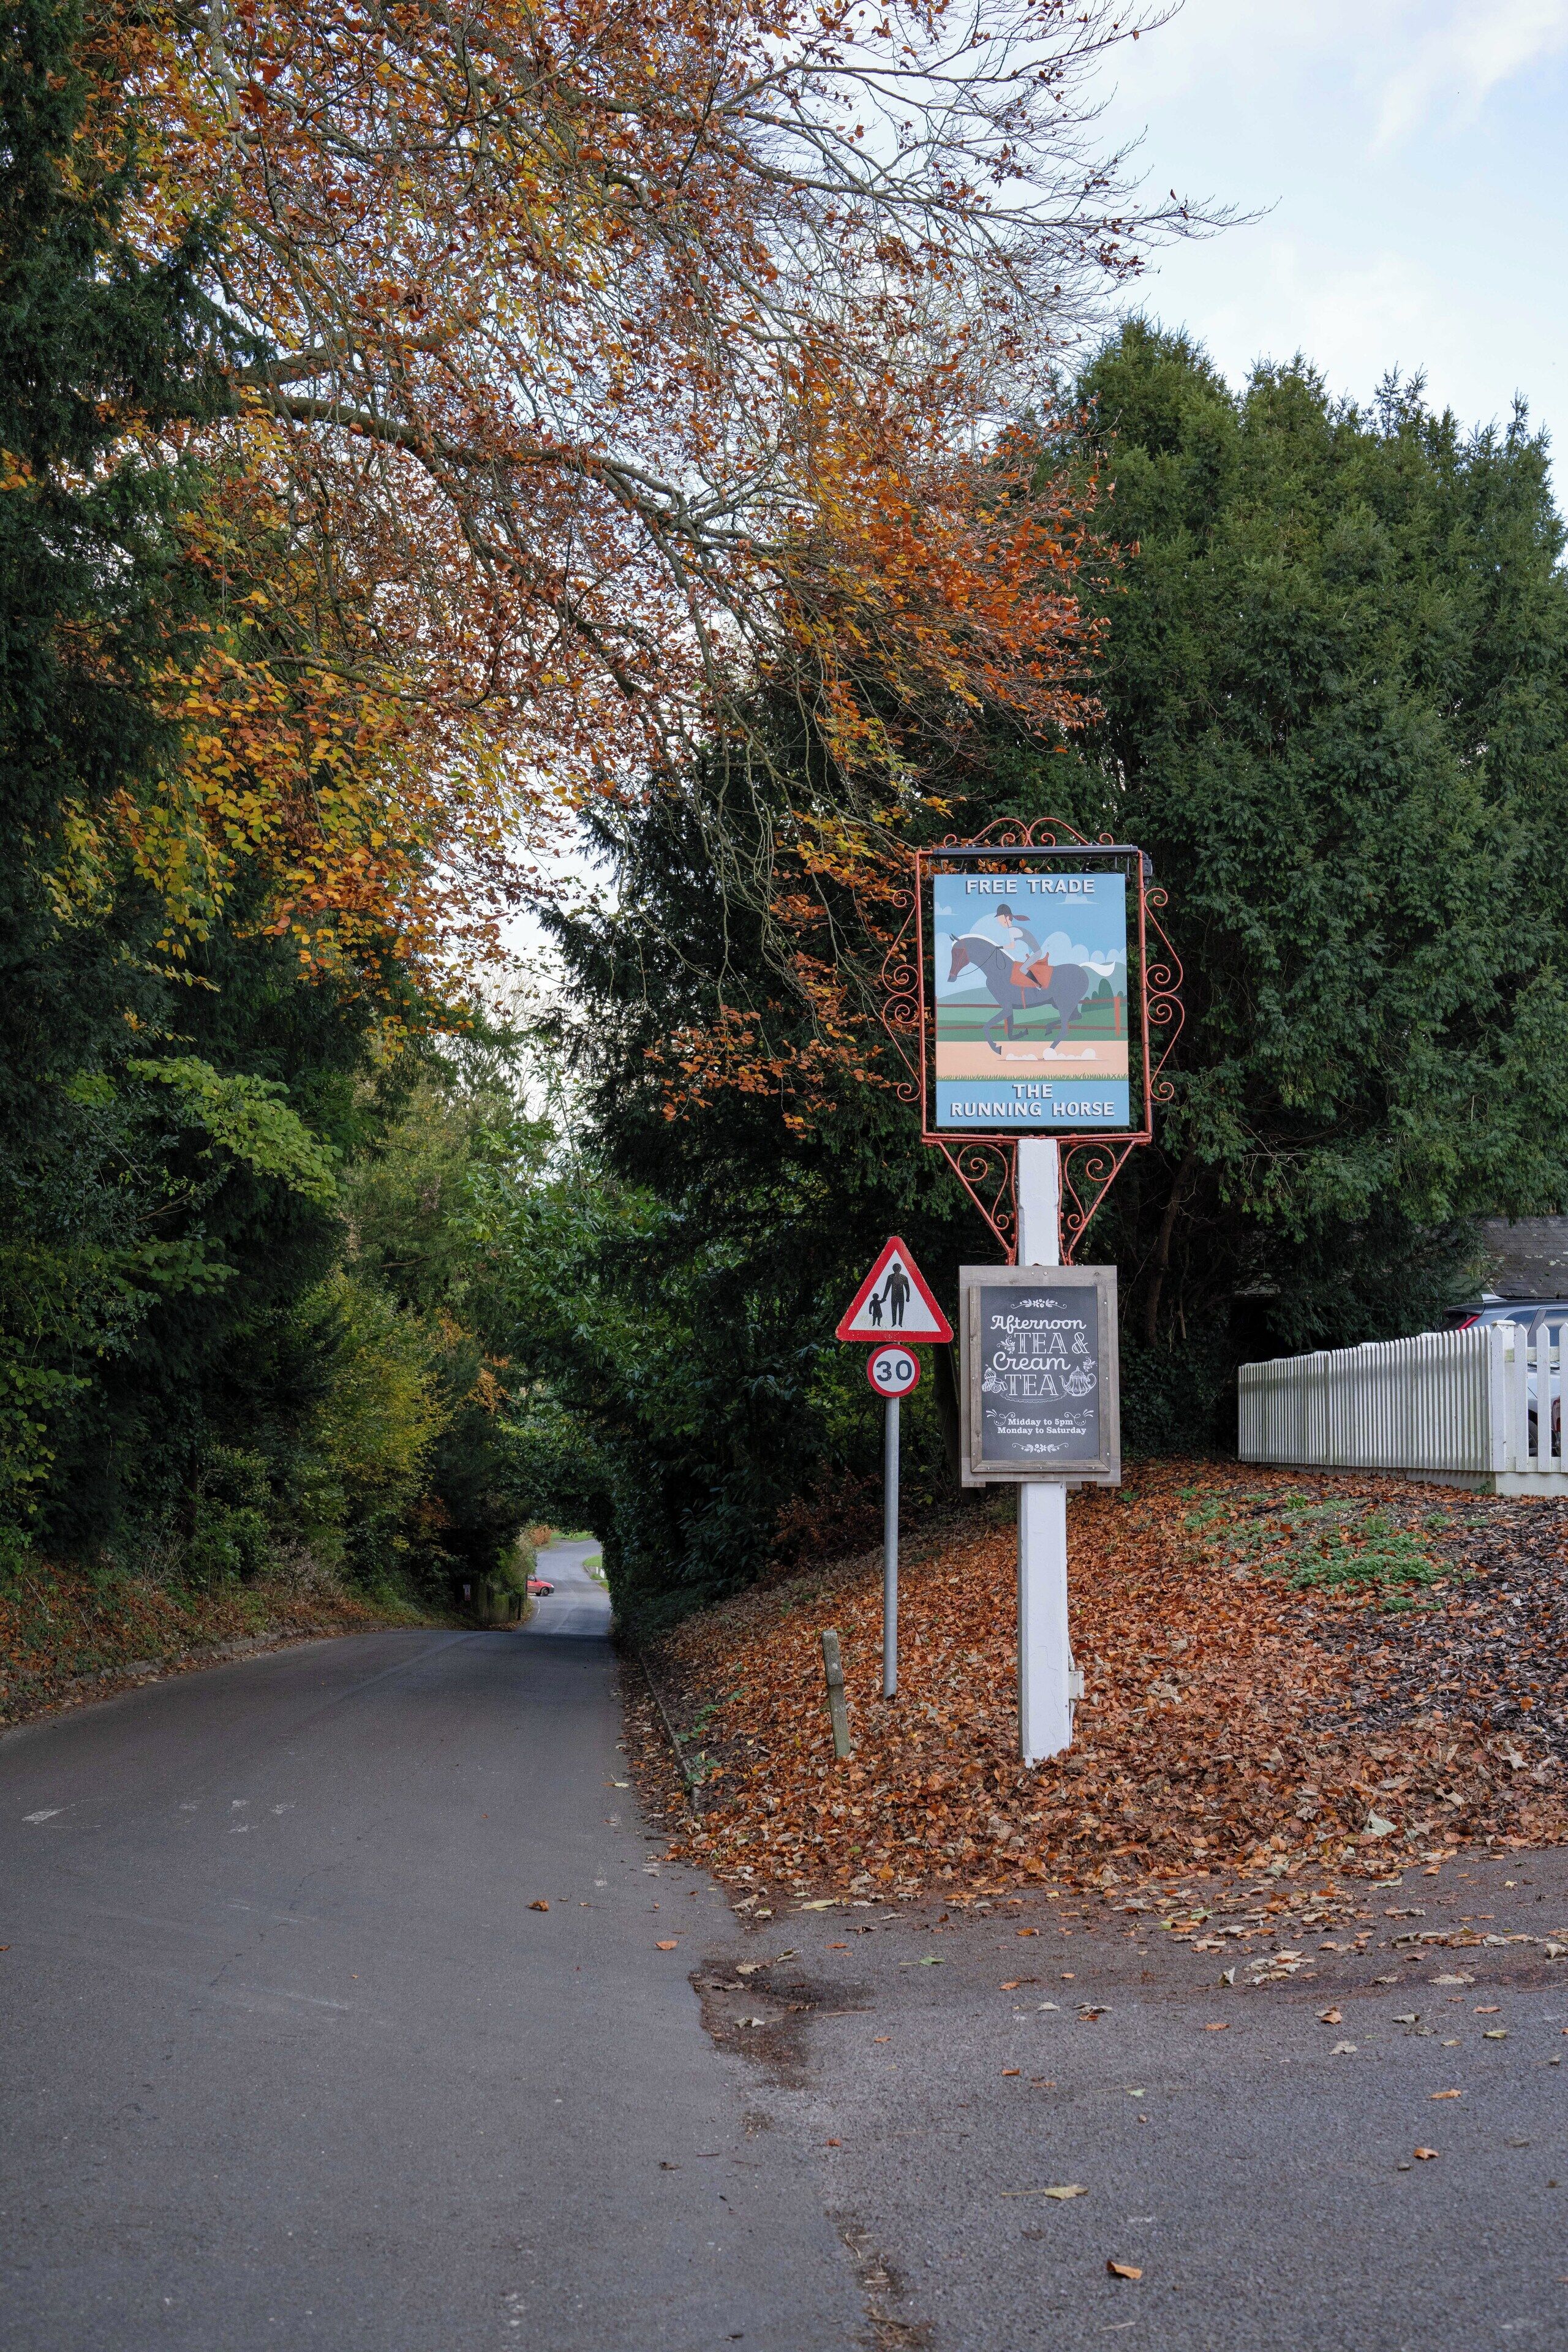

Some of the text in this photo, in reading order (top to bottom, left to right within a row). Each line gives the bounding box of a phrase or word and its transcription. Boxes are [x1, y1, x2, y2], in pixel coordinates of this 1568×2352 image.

[965, 879, 1096, 894] FREE TRADE
[1012, 1084, 1053, 1098] THE
[951, 1101, 1115, 1117] RUNNING HORSE
[990, 1315, 1087, 1334] Afternoon
[1014, 1332, 1090, 1354] TEA &
[993, 1351, 1071, 1371] Cream
[876, 1360, 913, 1382] 30
[1005, 1374, 1058, 1396] TEA
[1008, 1418, 1041, 1427] Midday
[997, 1427, 1033, 1436] Monday
[1046, 1427, 1087, 1436] Saturday
